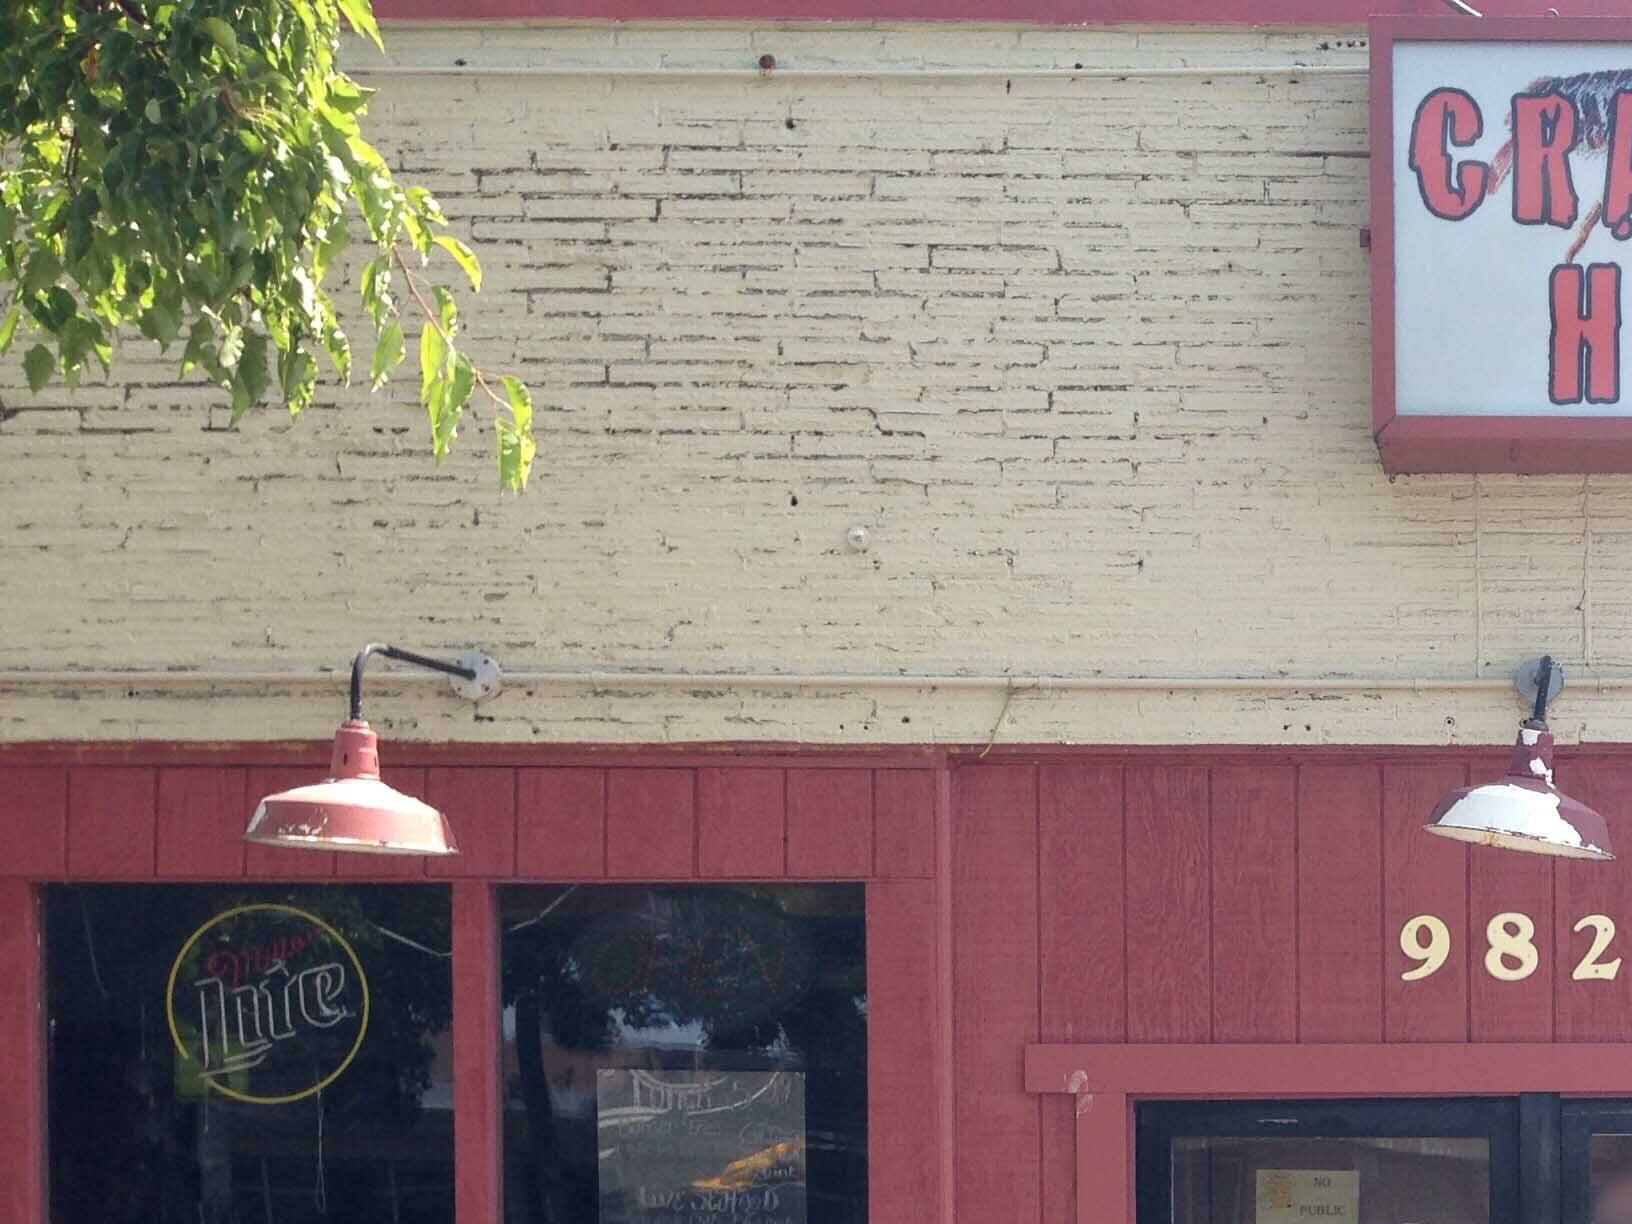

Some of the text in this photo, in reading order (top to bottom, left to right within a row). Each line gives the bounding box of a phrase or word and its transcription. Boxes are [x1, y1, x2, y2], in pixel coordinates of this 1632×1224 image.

[193, 958, 352, 1080] Lite
[1312, 1176, 1331, 1187] NO
[1299, 1204, 1345, 1216] PUBLIC
